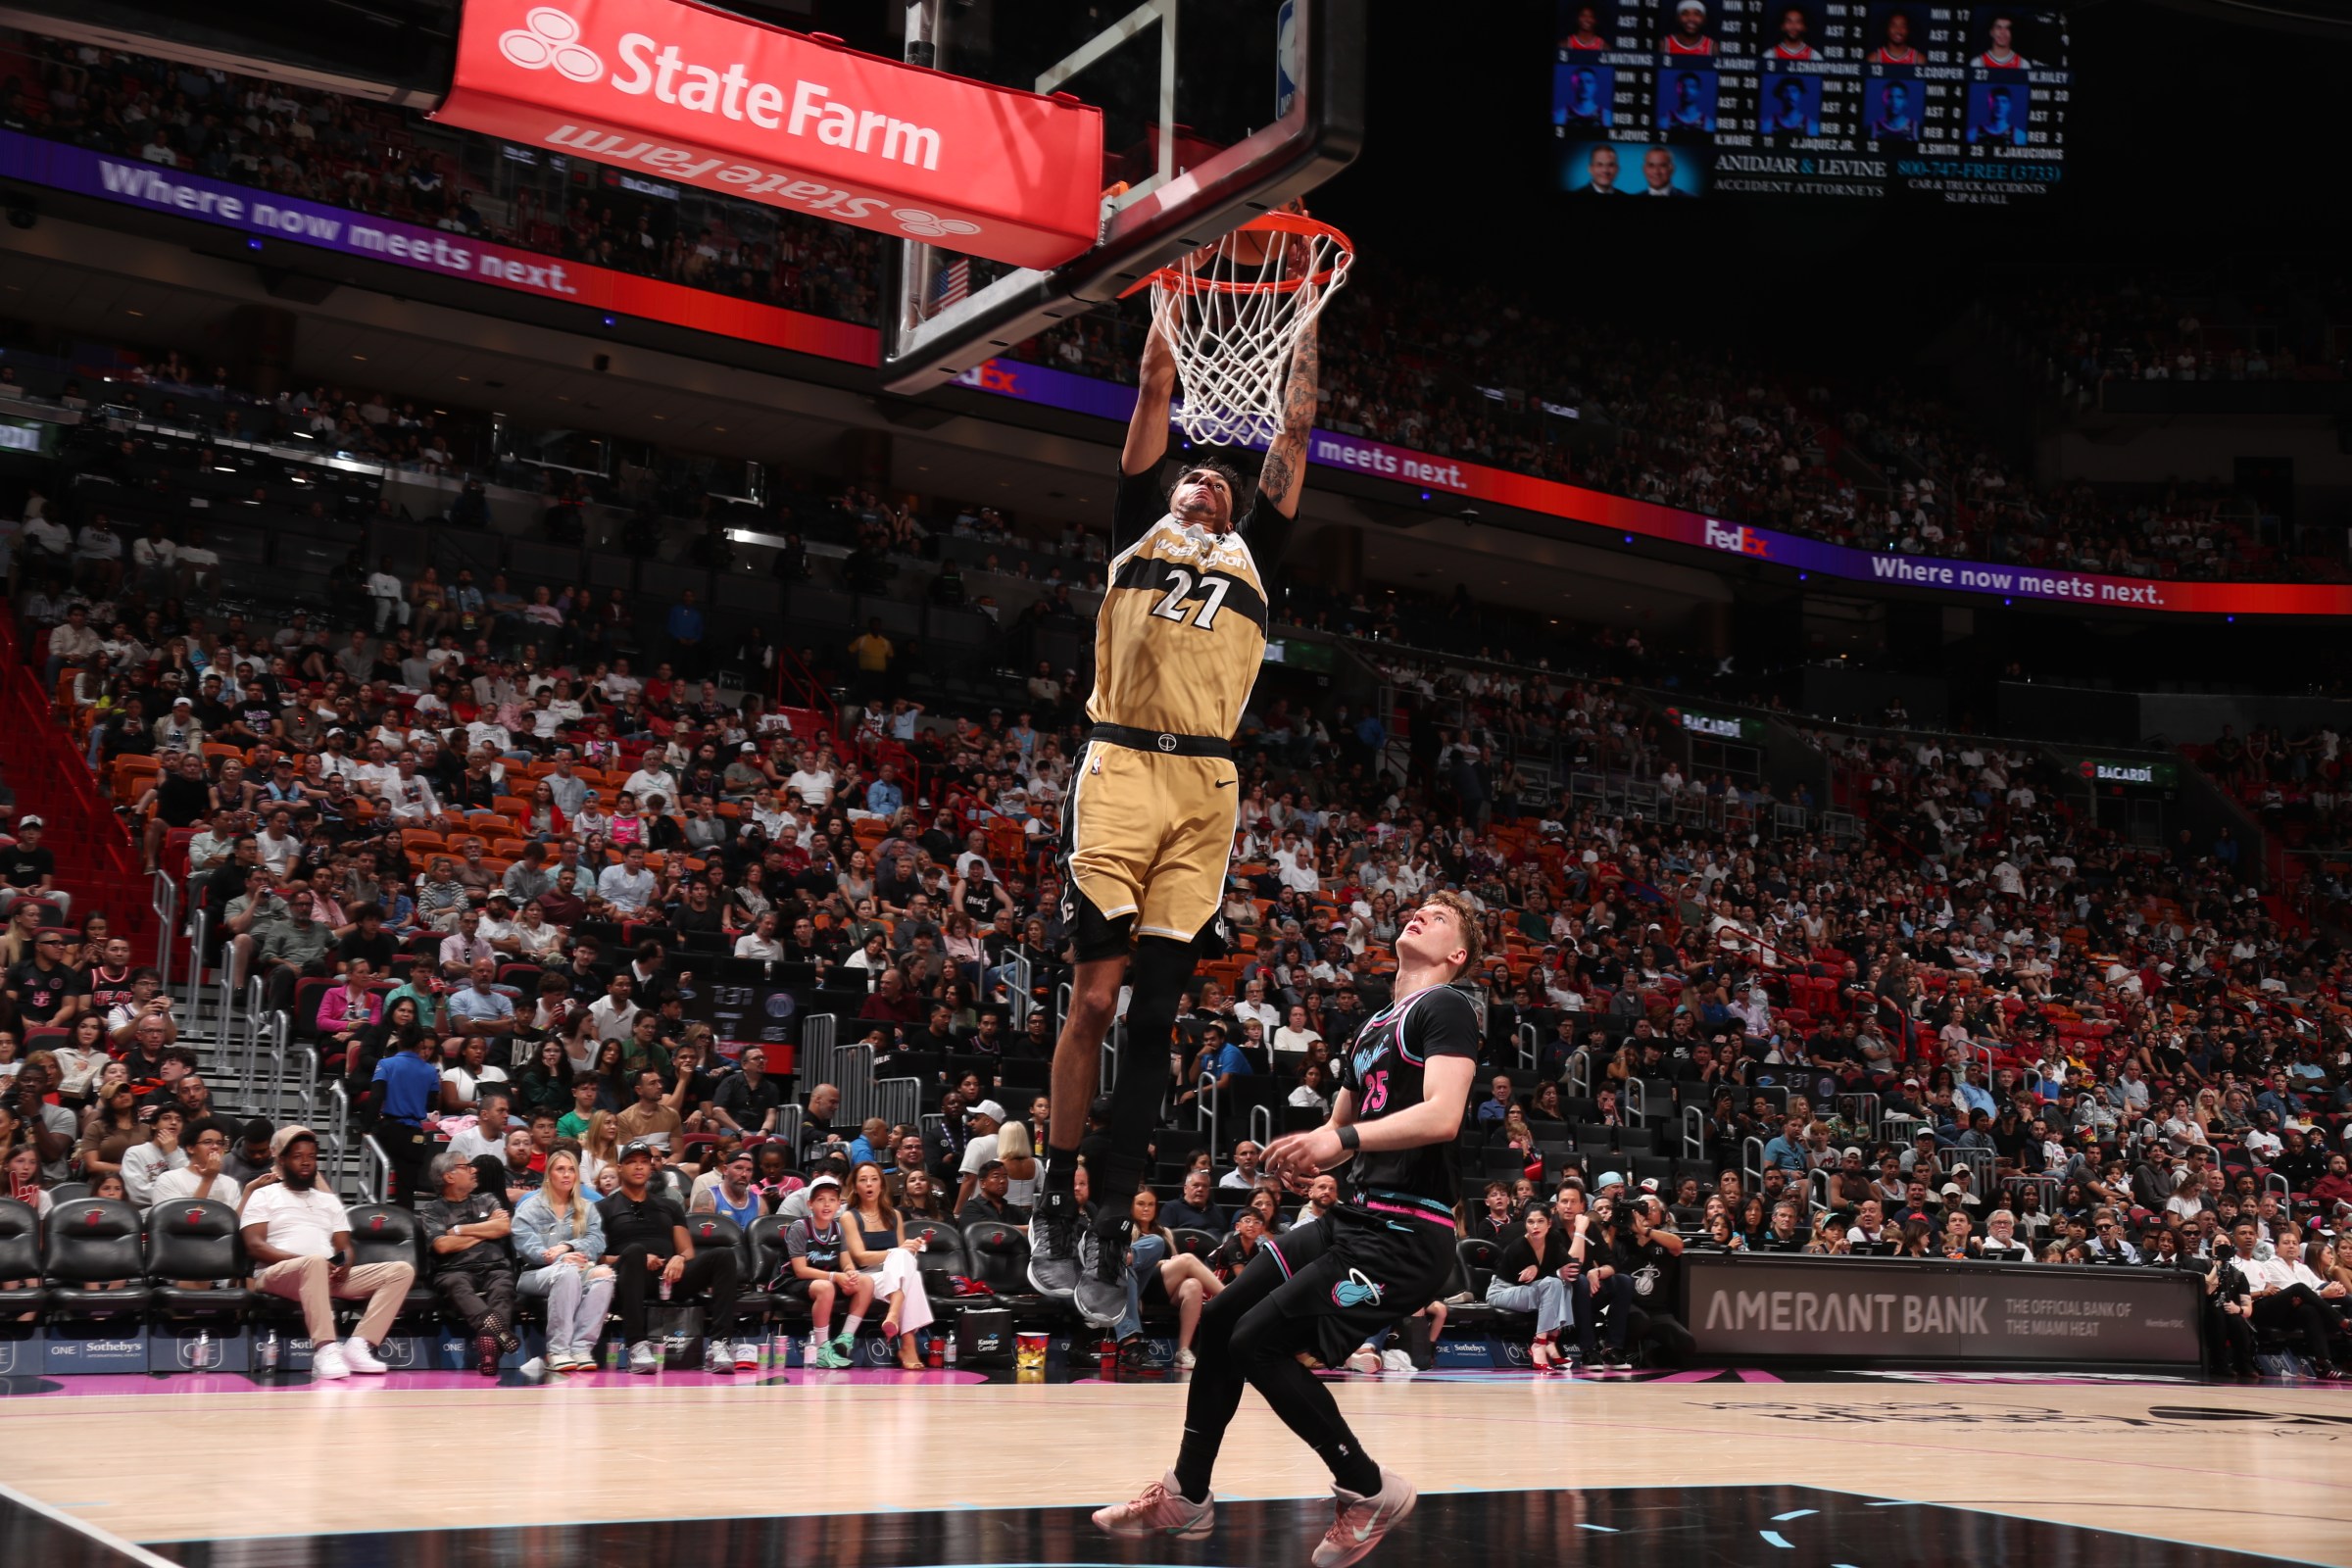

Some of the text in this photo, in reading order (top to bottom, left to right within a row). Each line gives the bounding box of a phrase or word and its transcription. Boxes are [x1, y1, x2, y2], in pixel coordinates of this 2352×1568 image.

[1722, 0, 1743, 12] MIN
[1826, 3, 1847, 17] MIN
[1617, 15, 1639, 28] AST
[1930, 8, 1951, 21] MIN
[1721, 20, 1742, 33] AST
[1825, 24, 1846, 38] AST
[1928, 28, 1950, 42] AST
[1614, 71, 1636, 84] MIN
[1718, 75, 1740, 88] MIN
[1821, 79, 1842, 93] MIN
[1925, 84, 1947, 98] MIN
[1613, 91, 1635, 105] AST
[2030, 89, 2051, 102] MIN
[1717, 96, 1739, 110] AST
[1820, 101, 1841, 115] AST
[1924, 106, 1945, 119] AST
[2028, 110, 2050, 123] AST
[1715, 153, 1887, 178] ANIDJAR & LEVINE
[1713, 178, 1885, 198] ACCIDENT ATTORNEYS
[1907, 178, 1934, 190] CAR
[1946, 179, 1983, 193] TRUCK
[1984, 181, 2047, 195] ACCIDENTS
[99, 160, 577, 295] Where now meets next.
[1317, 438, 1468, 490] meets next.
[1704, 519, 1771, 558] FedEx
[1153, 538, 1248, 571] Washigton
[1872, 557, 2165, 606] Where now meets next.
[1150, 567, 1231, 632] 27
[2097, 765, 2153, 784] BACARDÍ
[1360, 1070, 1389, 1115] 25
[807, 1250, 838, 1264] Miami
[1705, 1290, 1990, 1335] AMERANT BANK
[2005, 1298, 2132, 1317] THE OFFICIAL BANK OF
[2005, 1319, 2100, 1337] THE MIAMI HEAT
[86, 1340, 142, 1352] Sotheby's
[663, 1335, 686, 1344] Kaseya
[978, 1339, 999, 1348] Kaseya
[51, 1346, 77, 1355] ONE
[443, 1343, 465, 1351] ONE
[1454, 1344, 1487, 1353] Sotheby's
